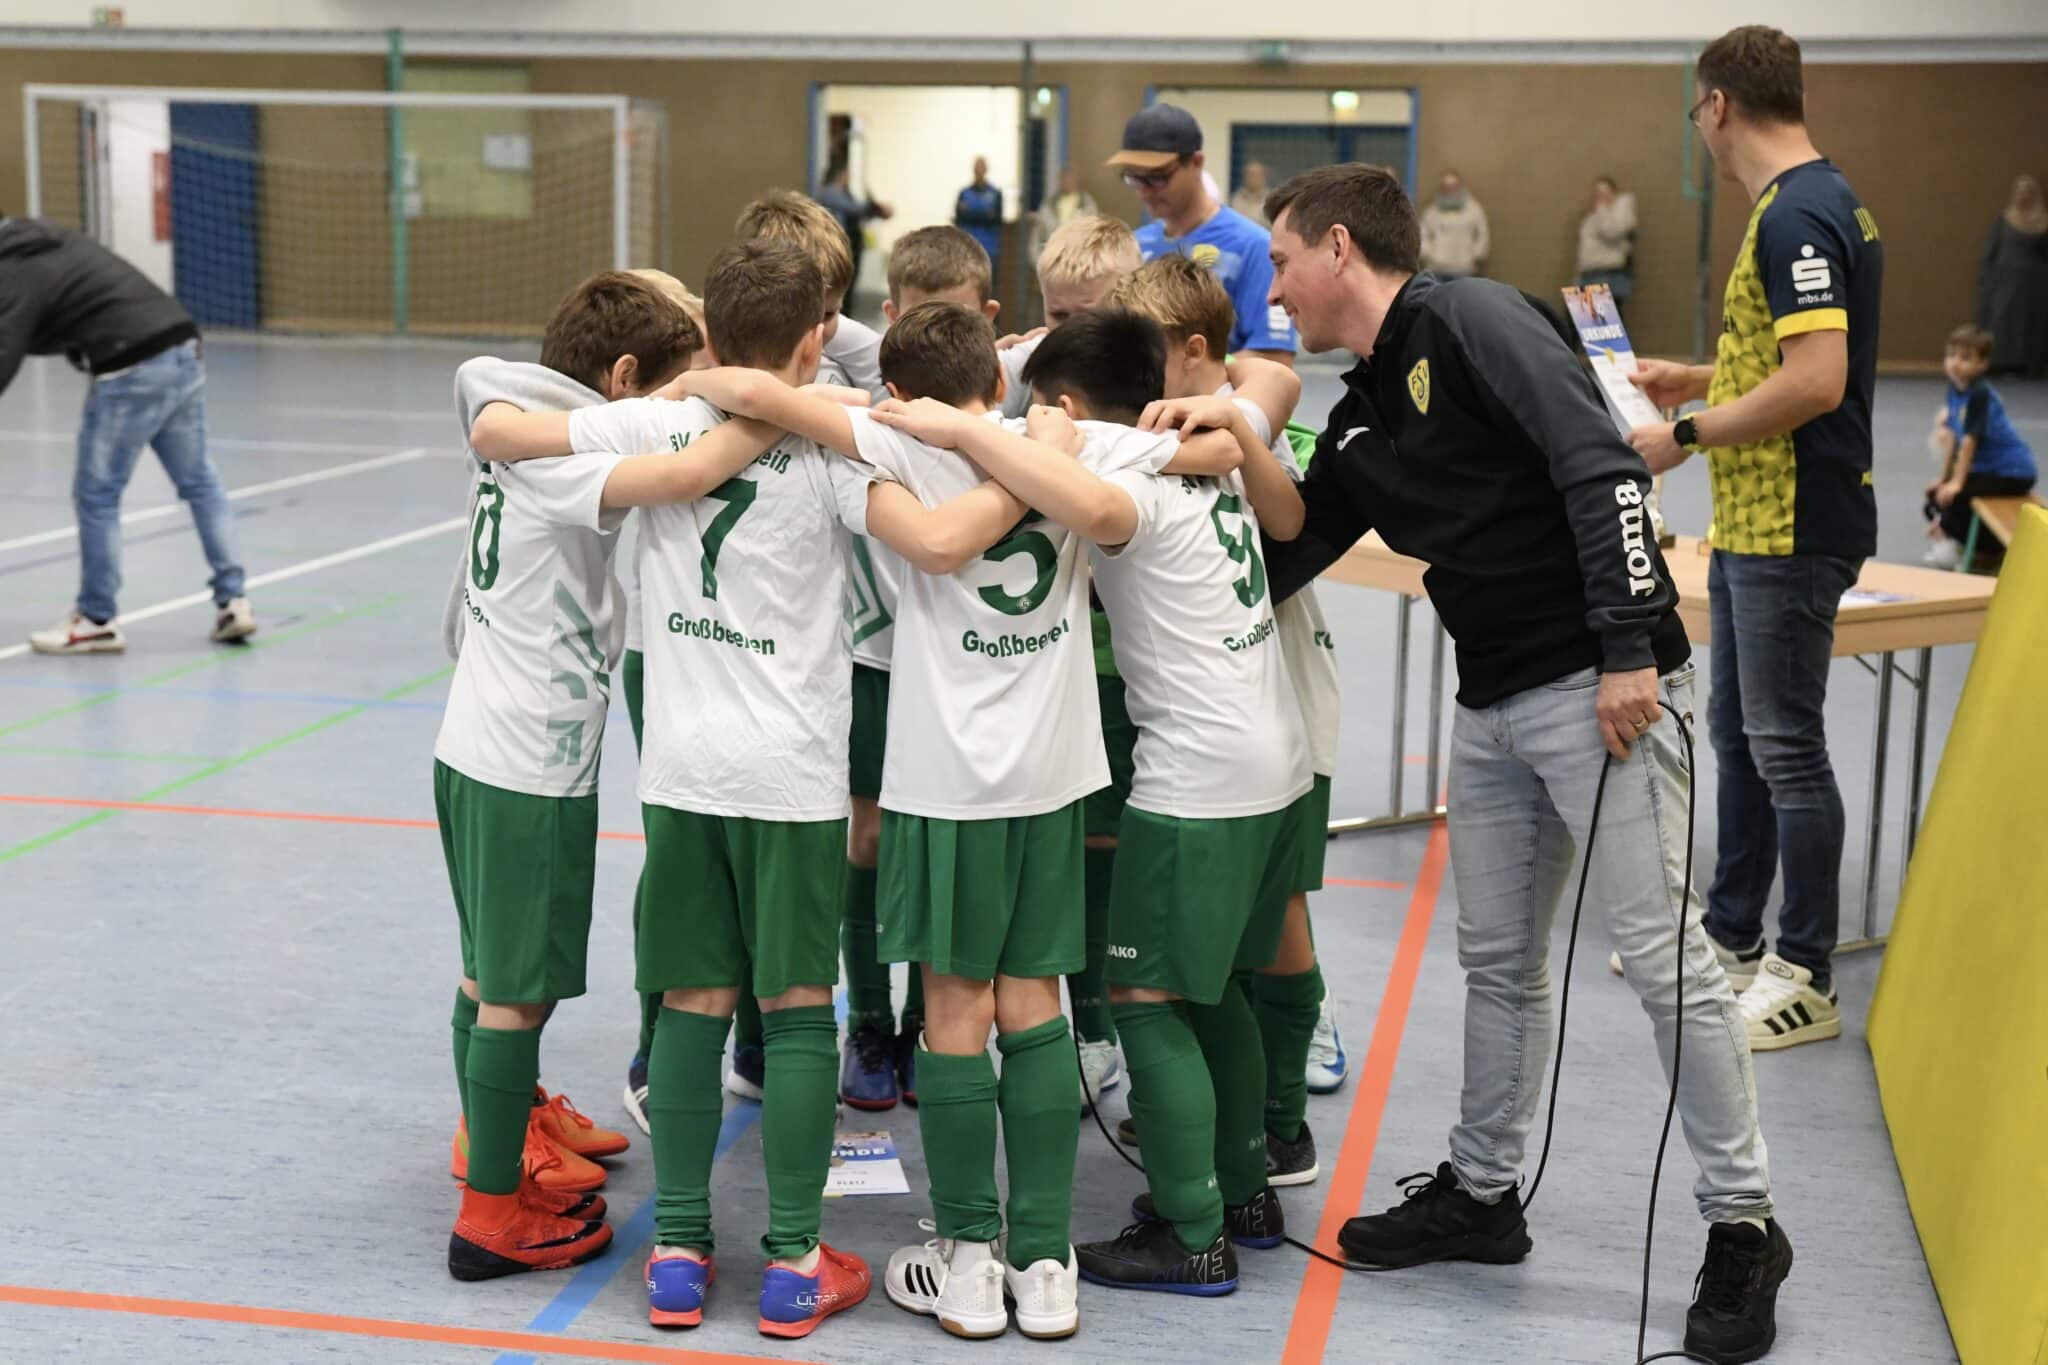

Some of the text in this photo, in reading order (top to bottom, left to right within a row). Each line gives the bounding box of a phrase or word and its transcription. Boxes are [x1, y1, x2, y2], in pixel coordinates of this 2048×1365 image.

[1797, 291, 1834, 305] mbs.de
[700, 477, 758, 602] 7
[977, 507, 1059, 616] 5
[796, 1292, 839, 1307] ULTRA
